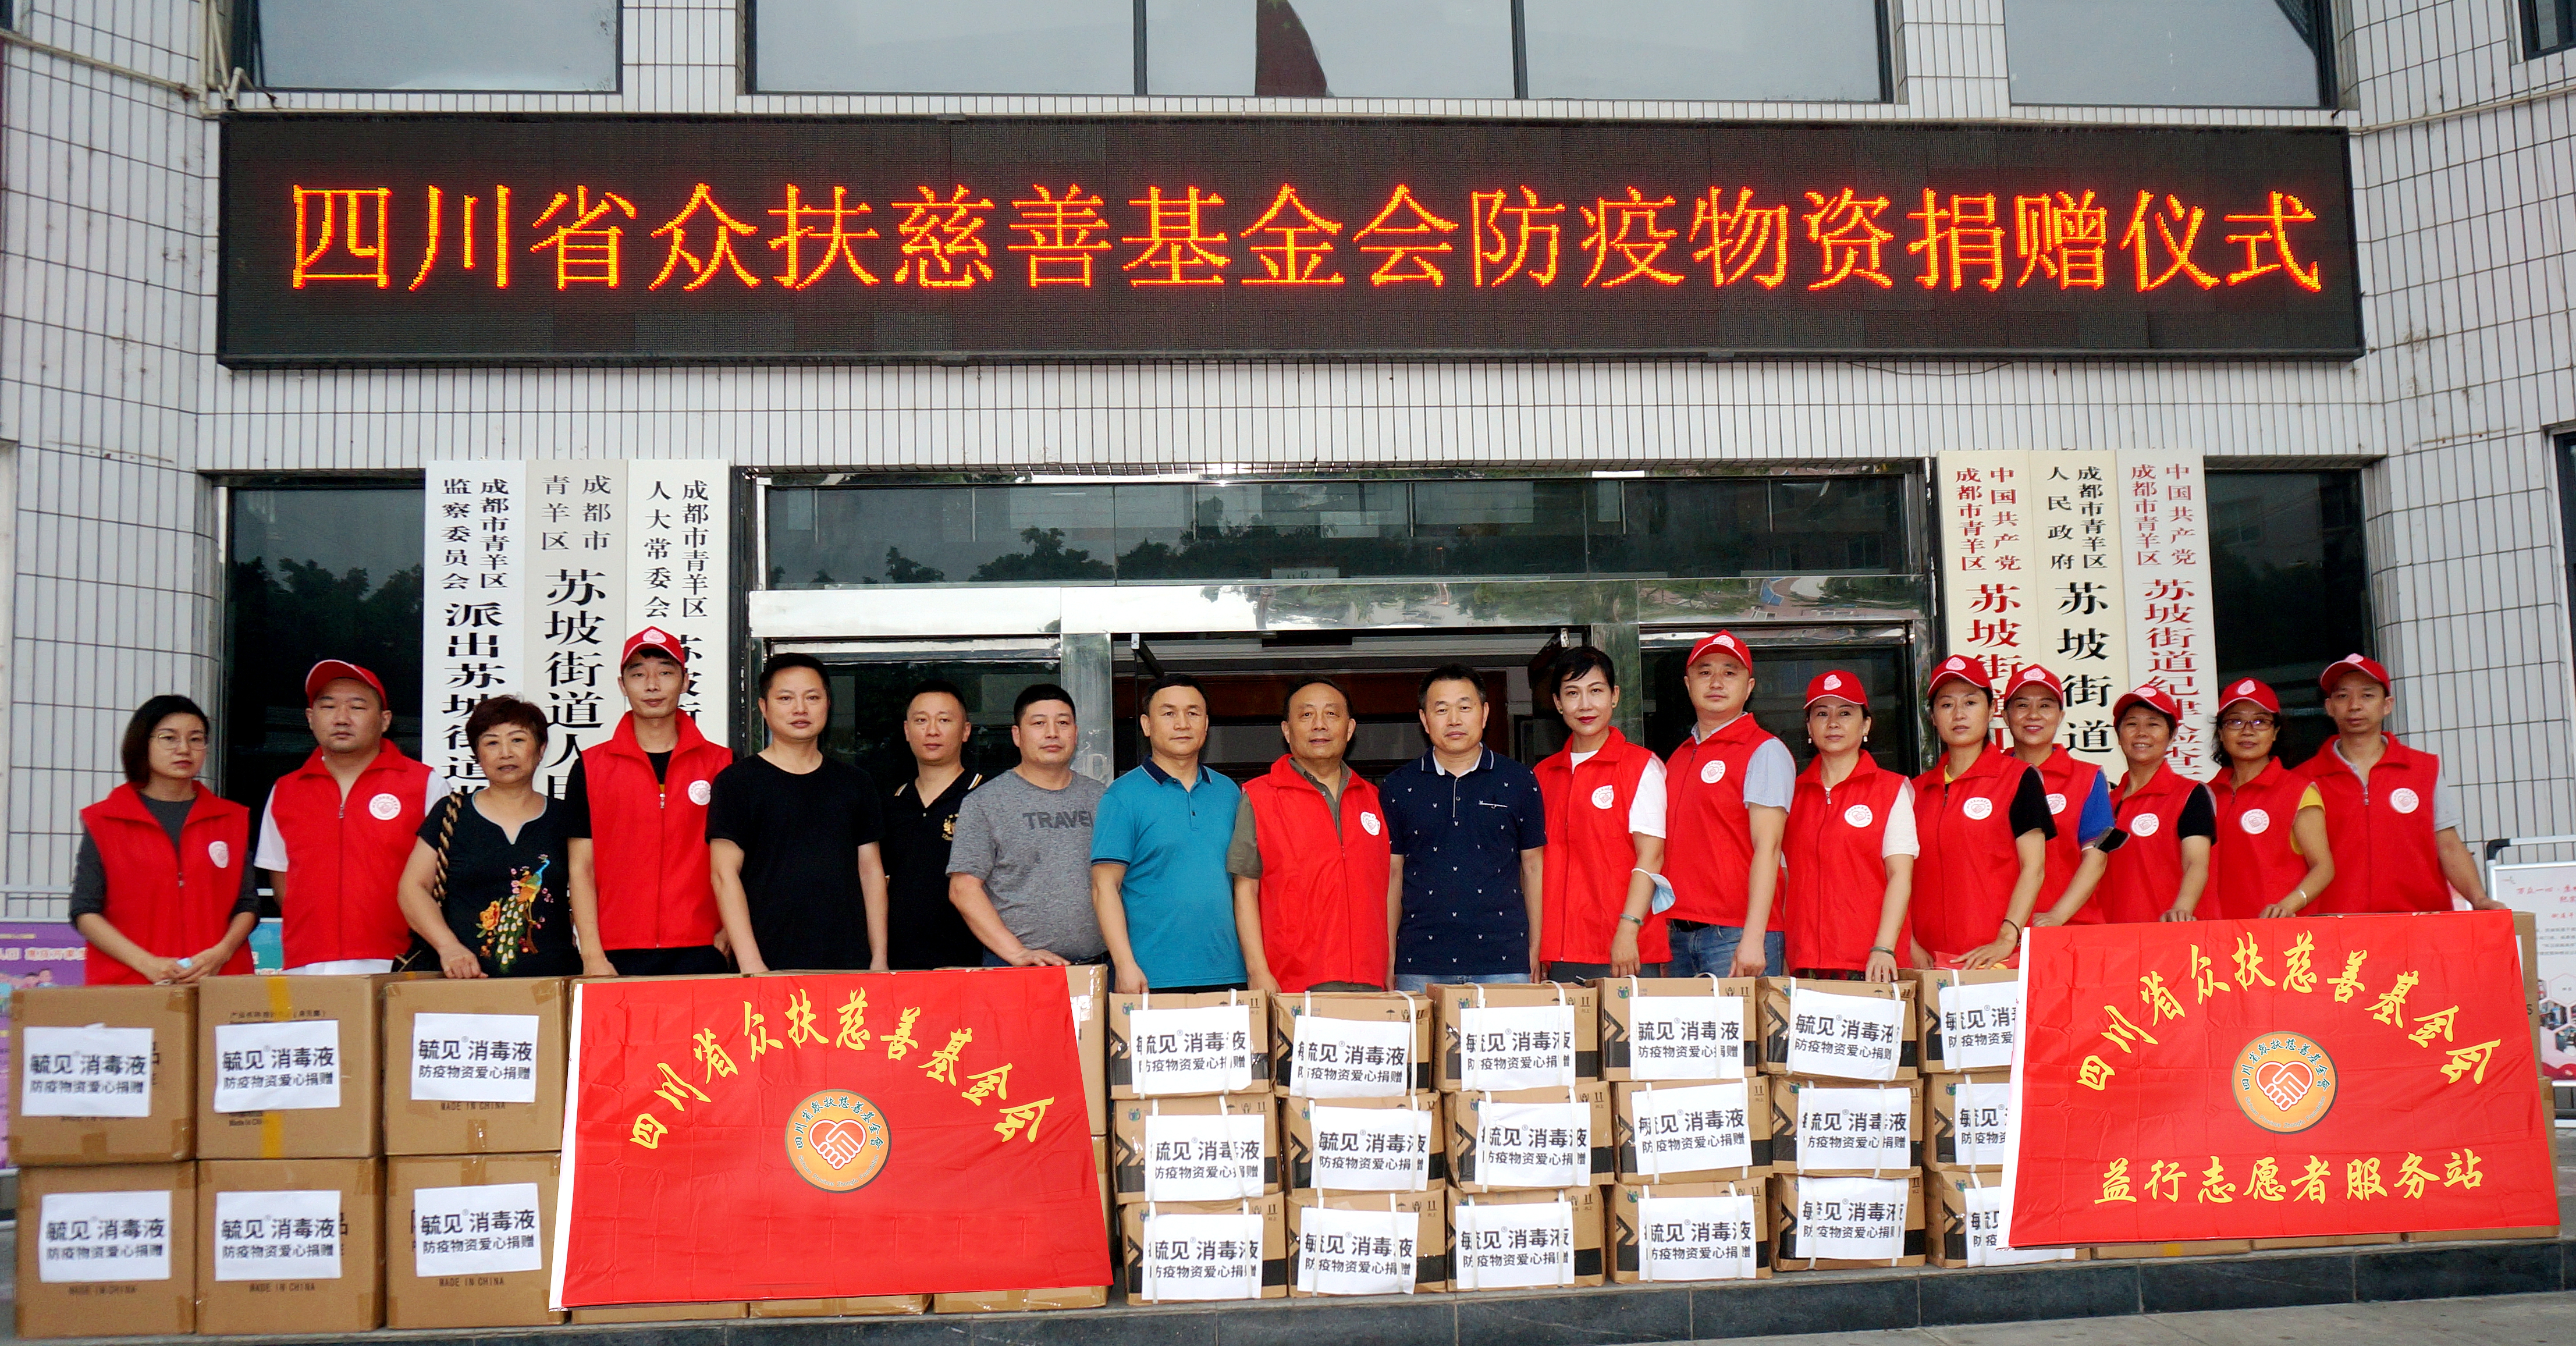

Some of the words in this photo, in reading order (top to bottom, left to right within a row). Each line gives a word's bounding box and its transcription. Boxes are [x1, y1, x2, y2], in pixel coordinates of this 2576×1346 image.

[293, 182, 2321, 291] 四川省众扶慈善基金会防疫物资捐赠仪式
[440, 478, 472, 590] 监察委员会
[479, 478, 510, 589] 成都市青羊区
[541, 475, 571, 551] 青羊区
[582, 475, 612, 551] 成都市
[644, 481, 671, 618] 人大常委会
[681, 480, 709, 617] 成都市青羊区
[1956, 467, 1987, 571] 成都市青羊区
[1990, 467, 2021, 571] 中国共产党
[2047, 466, 2074, 570] 人民政府
[2077, 466, 2108, 570] 成都市青羊区
[2131, 464, 2162, 566] 成都市青羊区
[2165, 464, 2197, 566] 中国共产党
[2055, 582, 2115, 753] 苏坡街道
[2076, 930, 2501, 1091] 四川省众扶慈善基金会
[223, 1071, 333, 1091] 防疫物资爱心捐赠
[418, 1065, 530, 1080] 防疫物资爱心捐赠
[628, 987, 1054, 1149] 四川省众扶慈善基金会
[2245, 1096, 2258, 1116] Sichuan
[2259, 1115, 2281, 1128] Province
[2284, 1120, 2305, 1128] Zhongfu
[2306, 1096, 2326, 1120] Foundation
[798, 1155, 812, 1174] Sichuan
[812, 1174, 834, 1187] Province
[837, 1179, 858, 1187] Zhongfu
[859, 1155, 879, 1180] Foundation
[2095, 1149, 2483, 1205] 益行志愿者服务站
[222, 1244, 333, 1259] 防疫物资爱心捐赠
[423, 1234, 534, 1255] 防疫物资爱心捐赠
[439, 1277, 460, 1287] MADE
[465, 1278, 474, 1287] IN
[478, 1277, 504, 1286] CHINA
